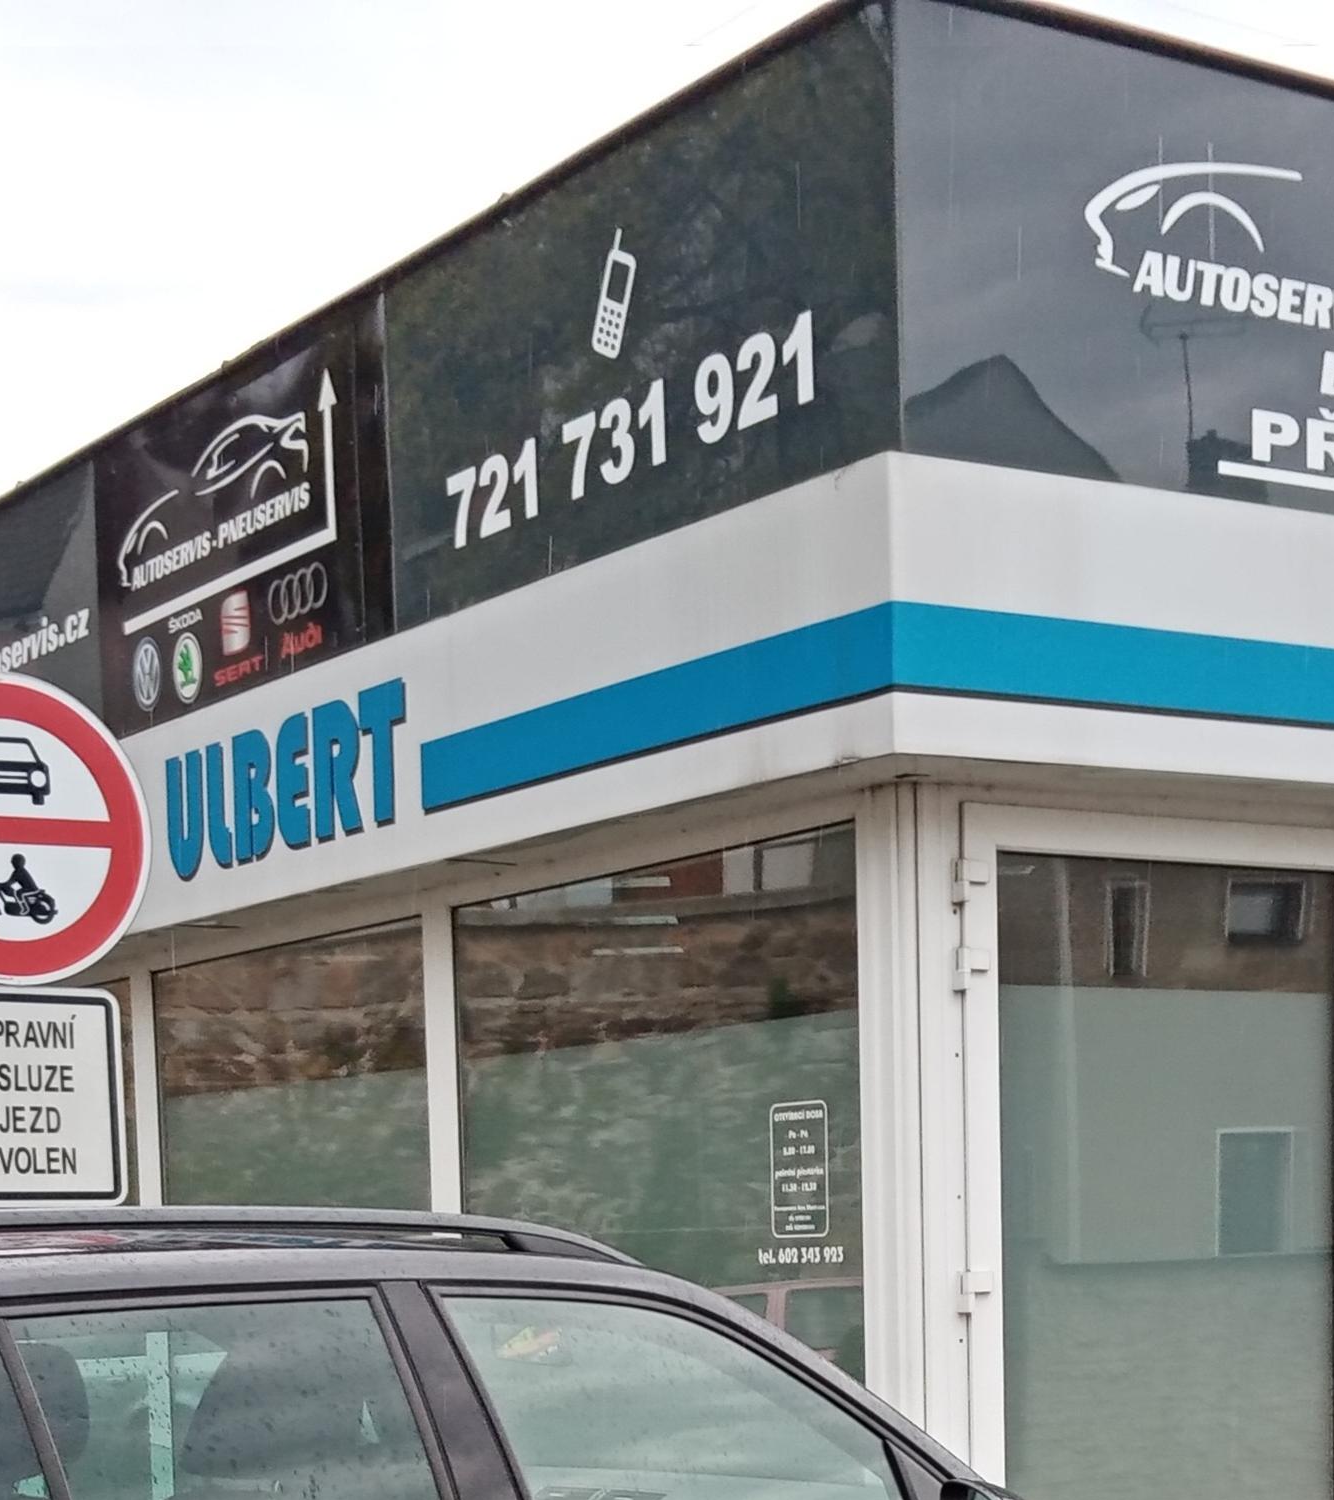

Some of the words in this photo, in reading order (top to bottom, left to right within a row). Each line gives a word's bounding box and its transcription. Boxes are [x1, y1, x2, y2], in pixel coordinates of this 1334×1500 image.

[446, 437, 539, 549] 721
[562, 378, 666, 500] 731
[694, 310, 815, 444] 921
[131, 531, 212, 591] AUTOSERVIS
[218, 481, 311, 549] PNEUSERVIS
[168, 608, 203, 635] ŠKODA
[280, 622, 323, 659] Audi
[213, 655, 265, 687] SEAT
[165, 677, 406, 881] ULBERT
[758, 1248, 776, 1265] tel.
[778, 1247, 799, 1264] 602
